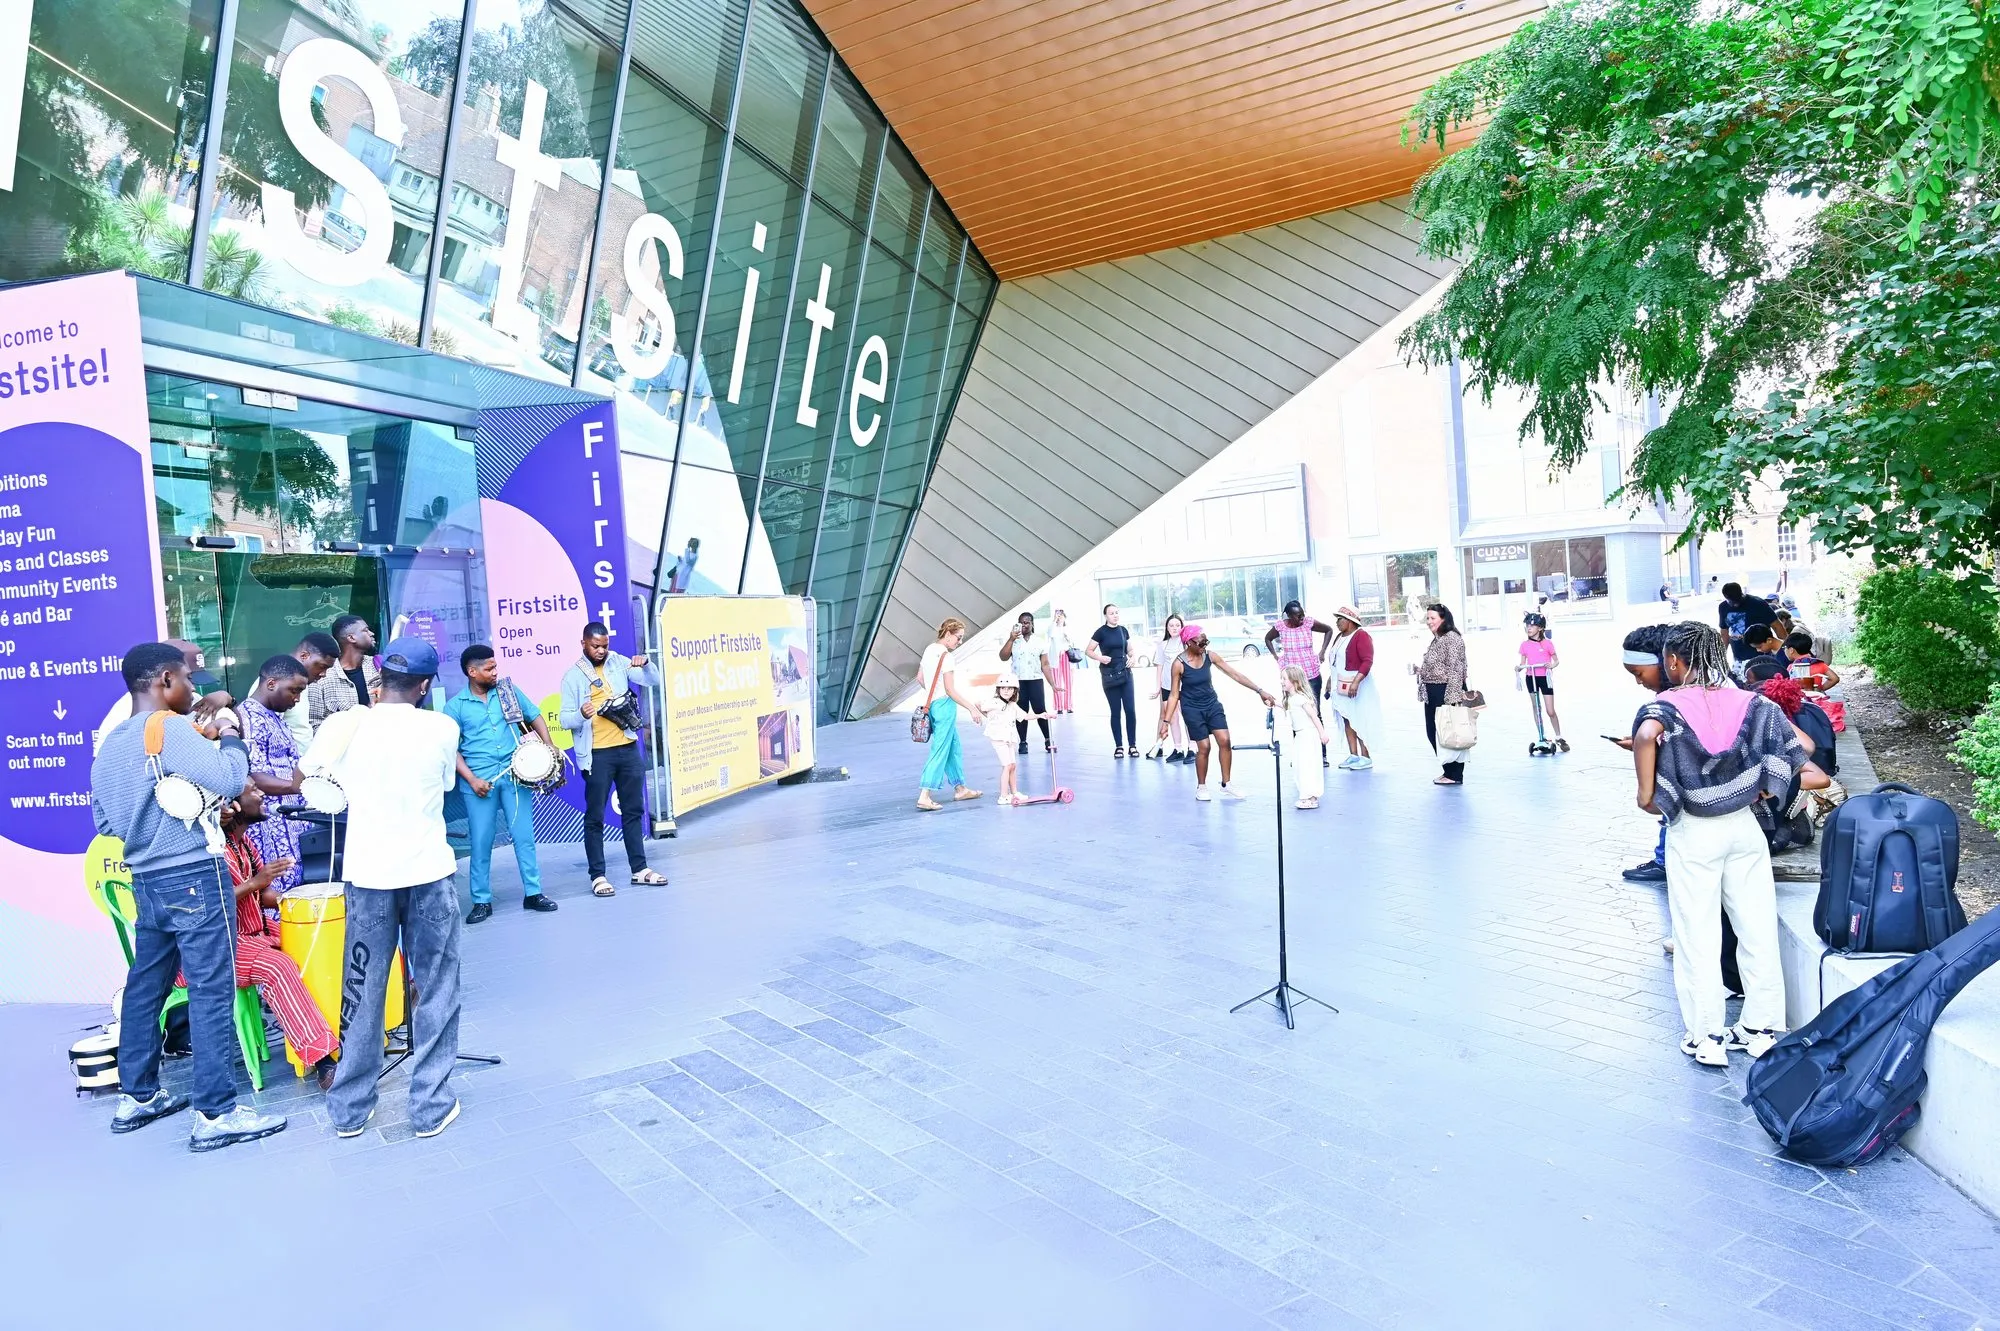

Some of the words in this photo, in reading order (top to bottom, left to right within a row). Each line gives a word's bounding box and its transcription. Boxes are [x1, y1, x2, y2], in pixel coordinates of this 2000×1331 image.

[59, 320, 78, 338] to
[27, 526, 56, 543] Fun
[16, 553, 45, 571] and
[49, 549, 109, 568] Classes
[1477, 545, 1526, 557] CURZON
[63, 574, 117, 594] Events
[498, 594, 579, 616] Firstsite
[13, 608, 42, 626] and
[46, 606, 72, 623] Bar
[500, 627, 533, 641] Open
[501, 647, 523, 658] Tue
[536, 644, 561, 656] Sun
[671, 634, 718, 661] Support
[720, 633, 762, 653] Firstsite
[30, 662, 41, 678] &
[44, 658, 98, 677] Events
[675, 661, 712, 699] and
[714, 657, 760, 692] Save!
[675, 708, 686, 718] Join
[687, 708, 695, 716] our
[696, 704, 712, 714] Mosaic
[713, 698, 740, 712] Membership
[6, 735, 38, 749] Scan
[41, 734, 55, 747] to
[57, 731, 84, 746] find
[9, 756, 31, 769] out
[33, 756, 66, 768] more
[680, 784, 691, 796] Join
[692, 781, 702, 792] here
[704, 777, 717, 790] today
[104, 858, 128, 874] Fre
